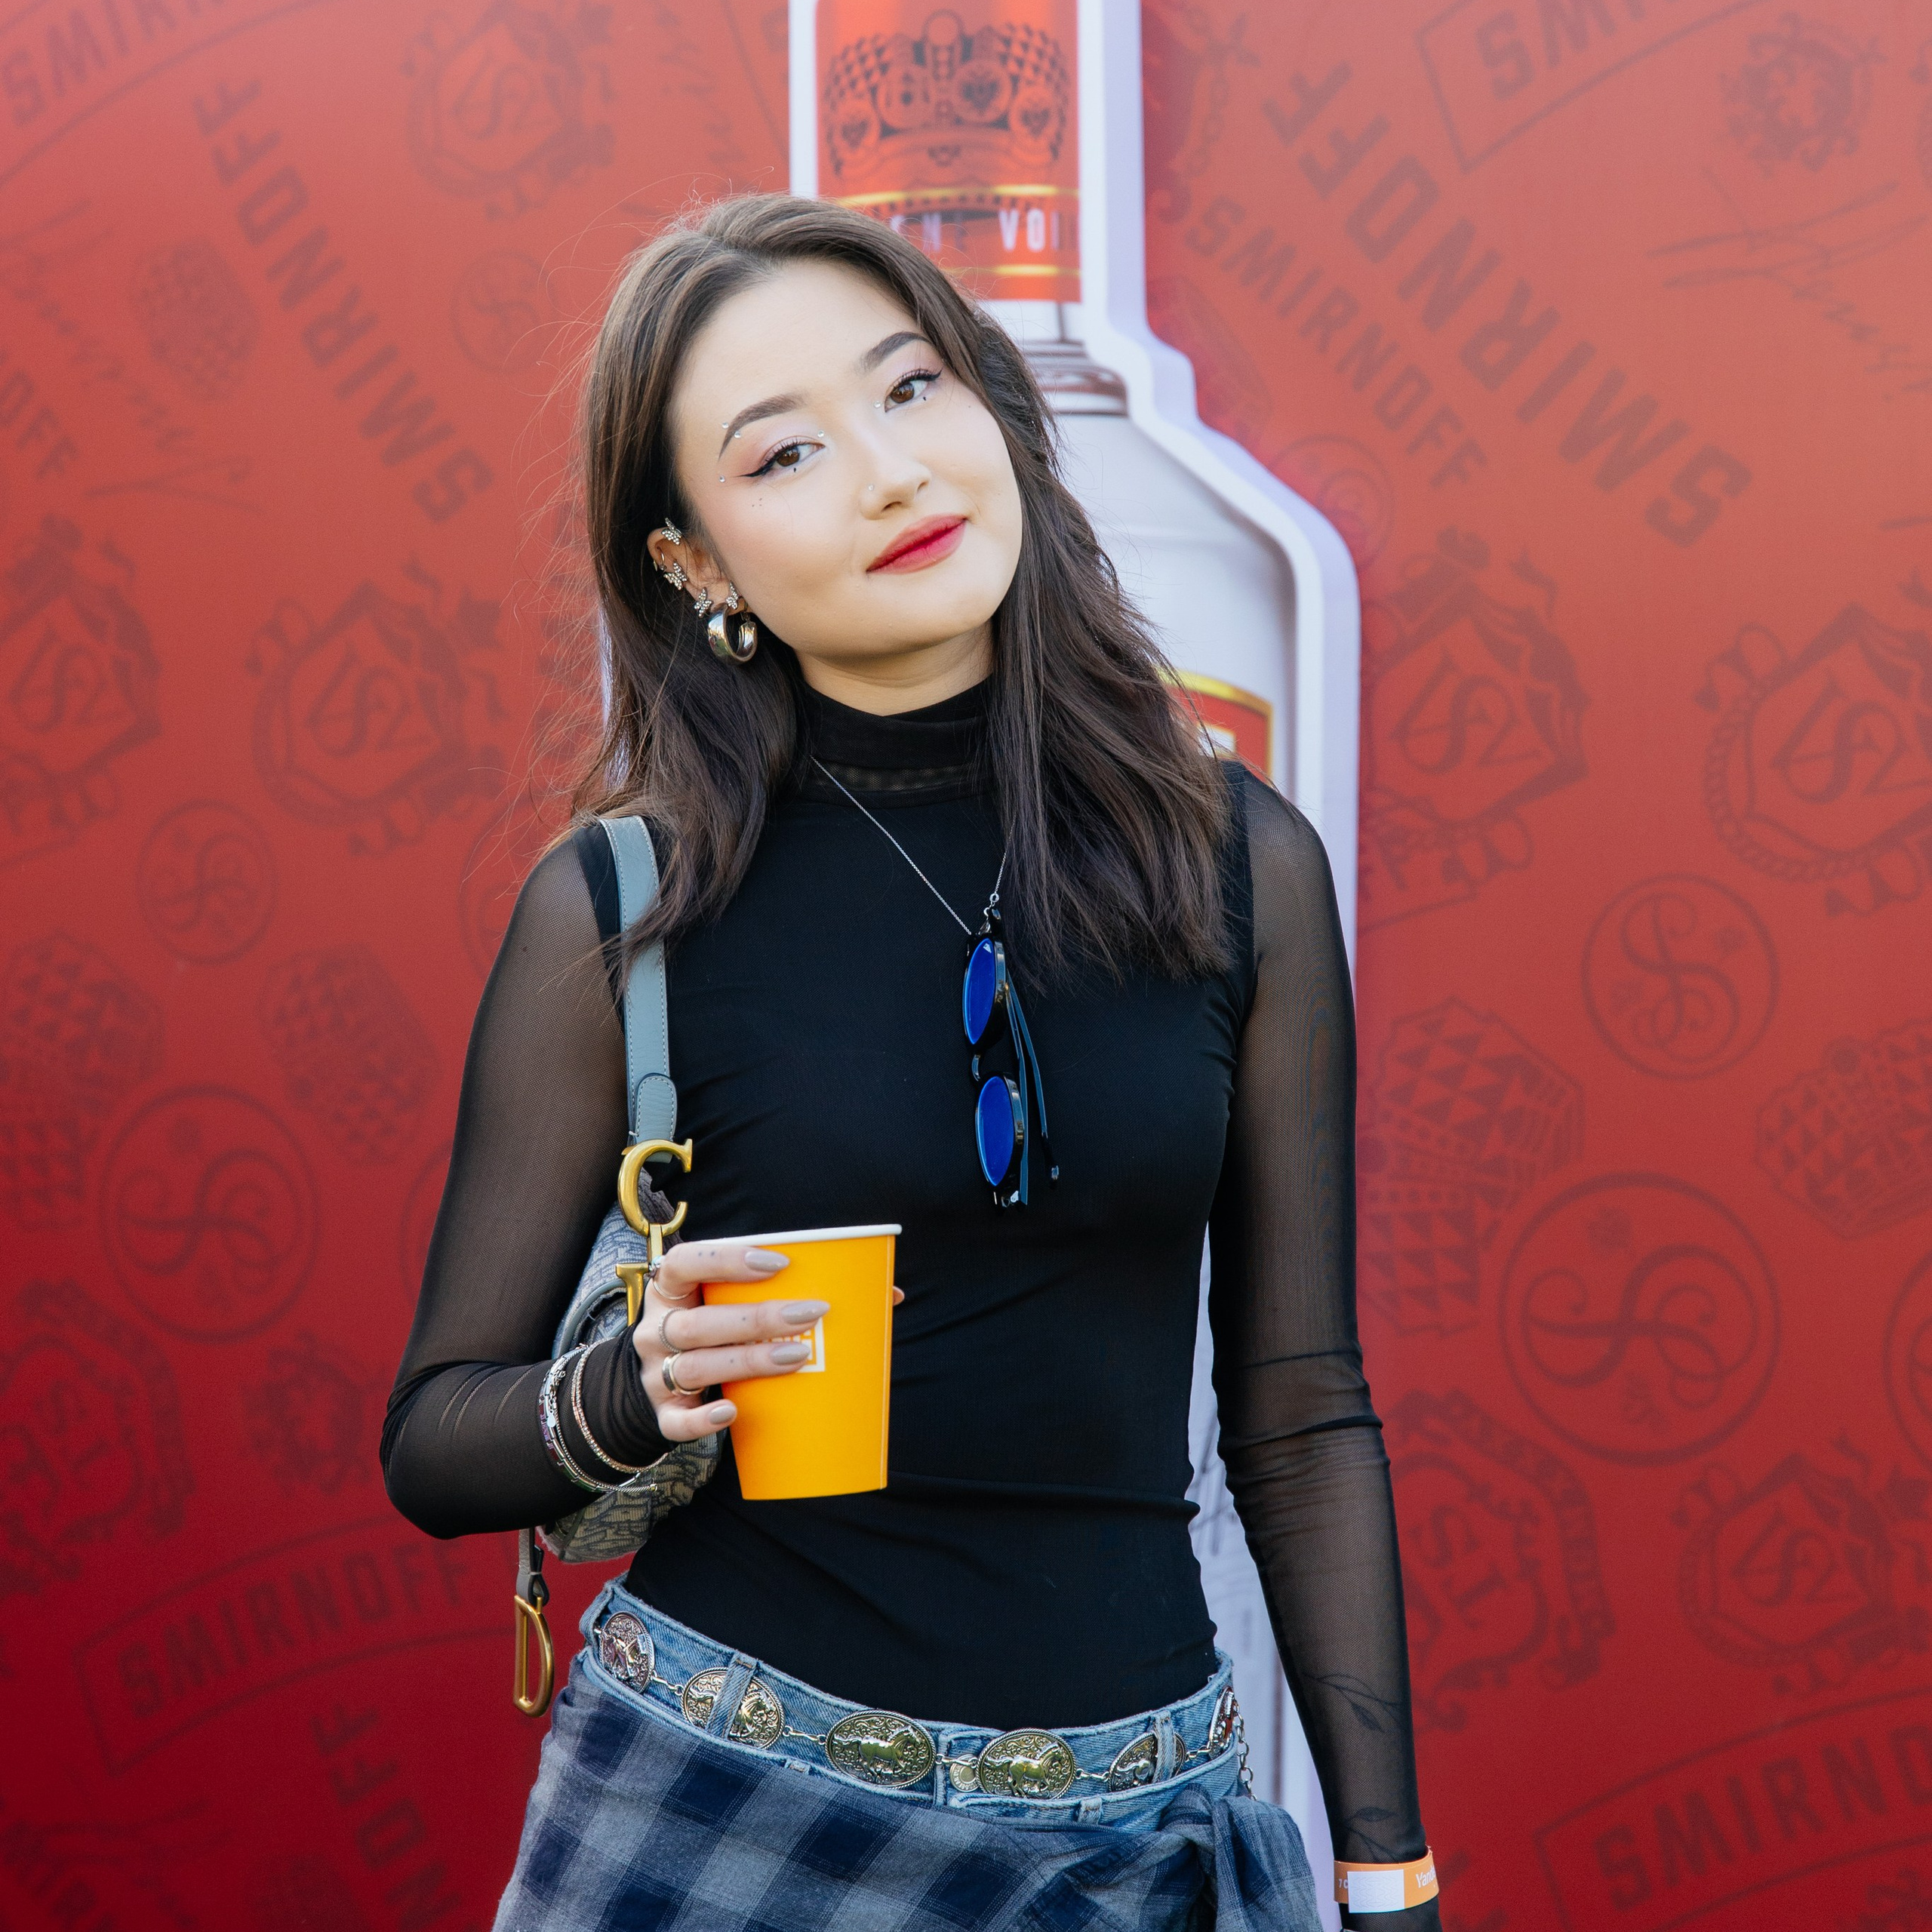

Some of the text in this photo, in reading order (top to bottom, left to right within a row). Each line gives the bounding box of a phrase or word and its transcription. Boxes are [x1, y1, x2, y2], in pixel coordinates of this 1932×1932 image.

[191, 78, 495, 524] SMIRNOFF
[1183, 195, 1489, 491] SMIRNOFF
[1260, 60, 1755, 549] SMIRNOFF
[117, 1538, 469, 1720] SMIRNOFF
